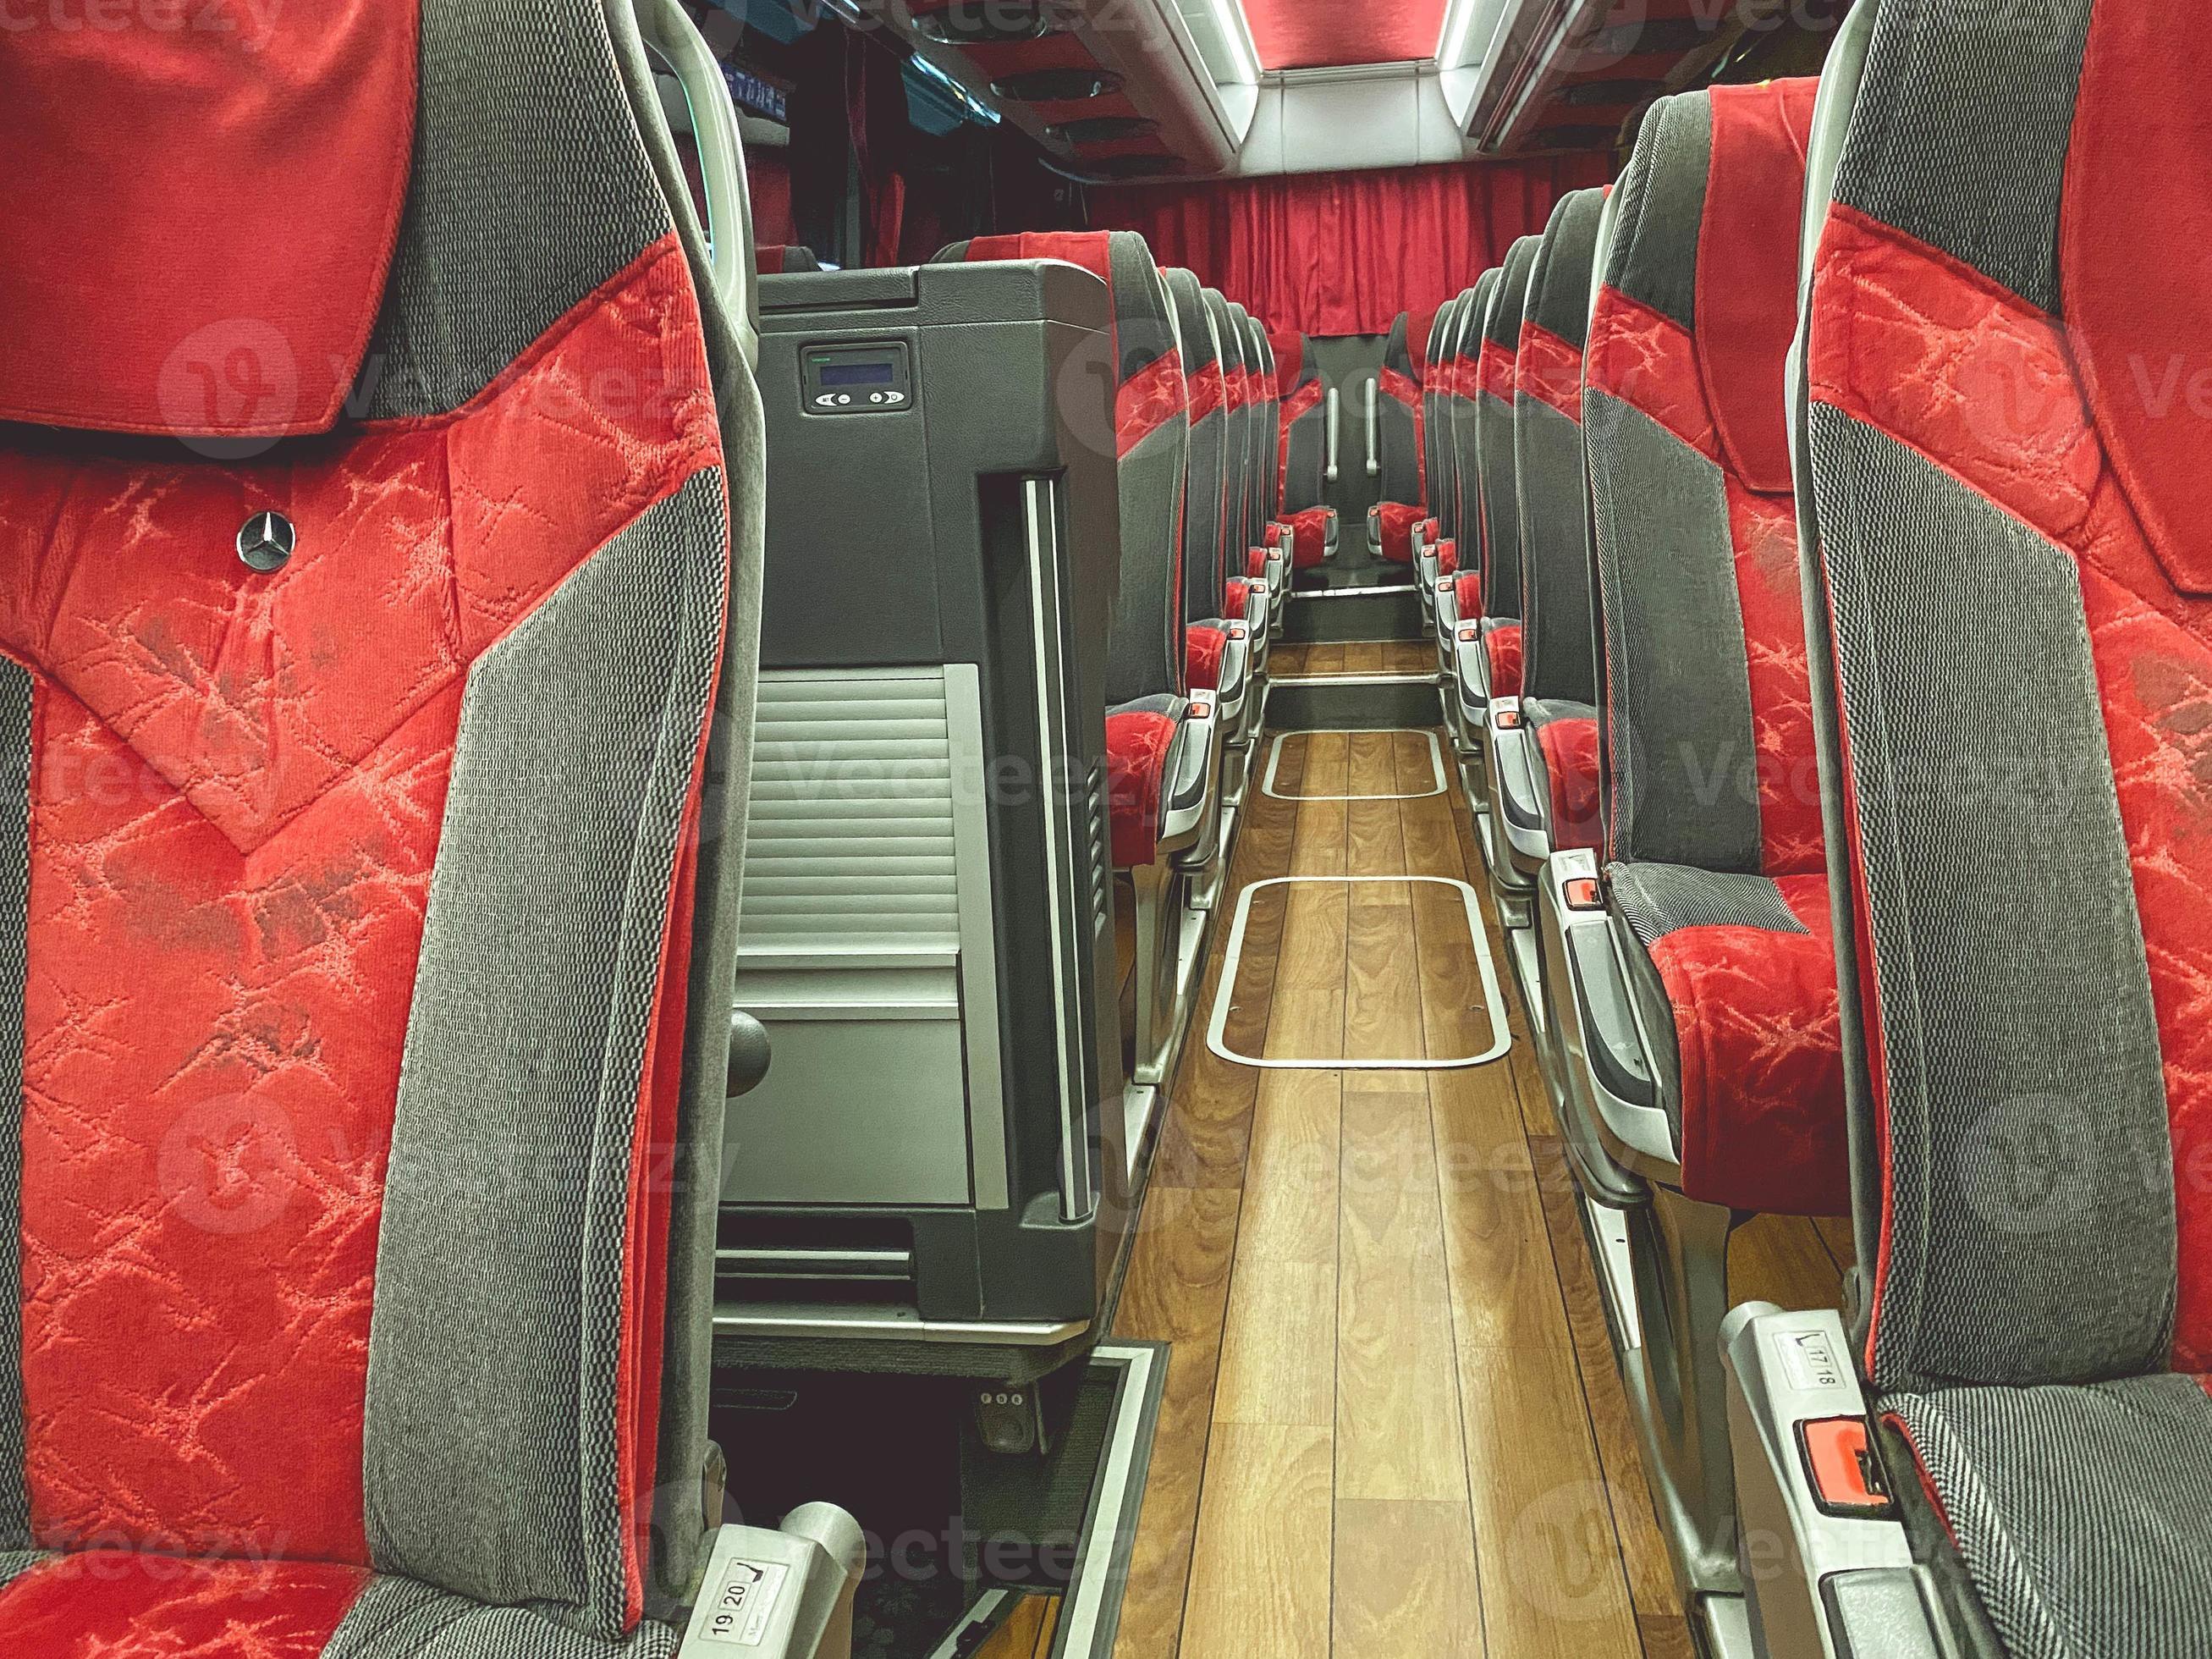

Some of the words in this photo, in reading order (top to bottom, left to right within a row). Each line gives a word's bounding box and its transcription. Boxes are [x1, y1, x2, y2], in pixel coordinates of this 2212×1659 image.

[1809, 1350, 1828, 1363] 17
[1817, 1370, 1835, 1384] 18
[712, 1615, 734, 1635] 19
[723, 1585, 746, 1606] 20
